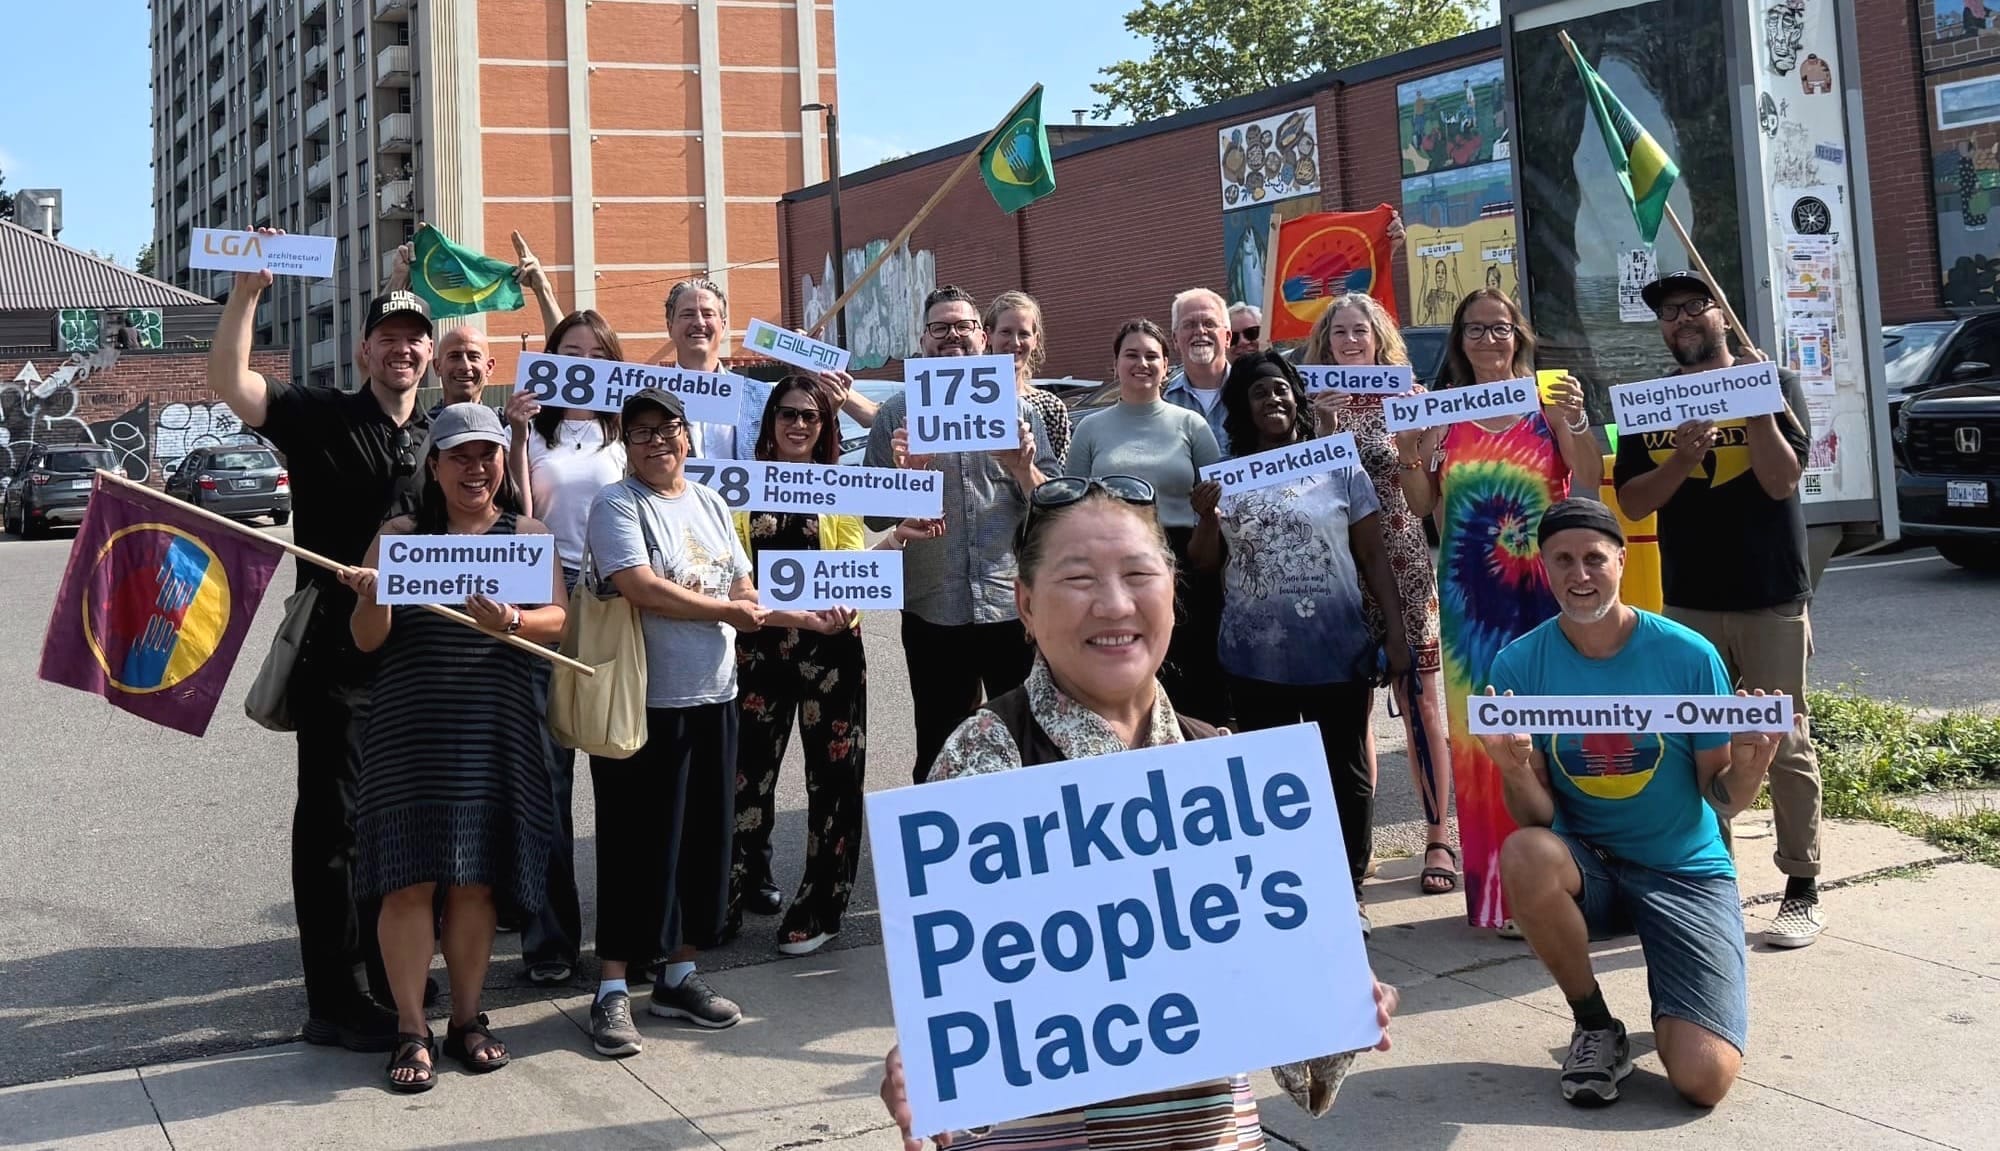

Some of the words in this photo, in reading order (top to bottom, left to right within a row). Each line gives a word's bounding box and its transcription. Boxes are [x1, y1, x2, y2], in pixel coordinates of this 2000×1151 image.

[204, 233, 262, 257] LGA
[268, 251, 321, 262] architectural
[391, 289, 416, 302] QUE
[777, 333, 840, 367] GILLAM
[524, 360, 596, 405] 88
[608, 366, 732, 397] Affordable
[914, 366, 1001, 407] 175
[1325, 371, 1400, 388] Clare's
[1619, 370, 1772, 407] Neighbourhood
[1392, 402, 1419, 422] by
[1425, 386, 1526, 416] Parkdale
[1624, 407, 1673, 428] Land
[1675, 399, 1729, 419] Trust
[918, 414, 1006, 442] Units
[1209, 469, 1245, 486] For
[1249, 443, 1353, 479] Parkdale,
[684, 465, 750, 507] 78
[764, 466, 935, 492] Rent-Controlled
[763, 486, 837, 505] Homes
[389, 542, 543, 566] Community
[387, 574, 499, 595] Benefits
[770, 558, 805, 602] 9
[813, 560, 879, 578] Artist
[814, 581, 892, 599] Homes
[1478, 702, 1652, 731] Community
[1663, 701, 1782, 725] -Owned
[899, 756, 1312, 897] Parkdale
[913, 855, 1308, 999] People's
[928, 992, 1200, 1102] Place
